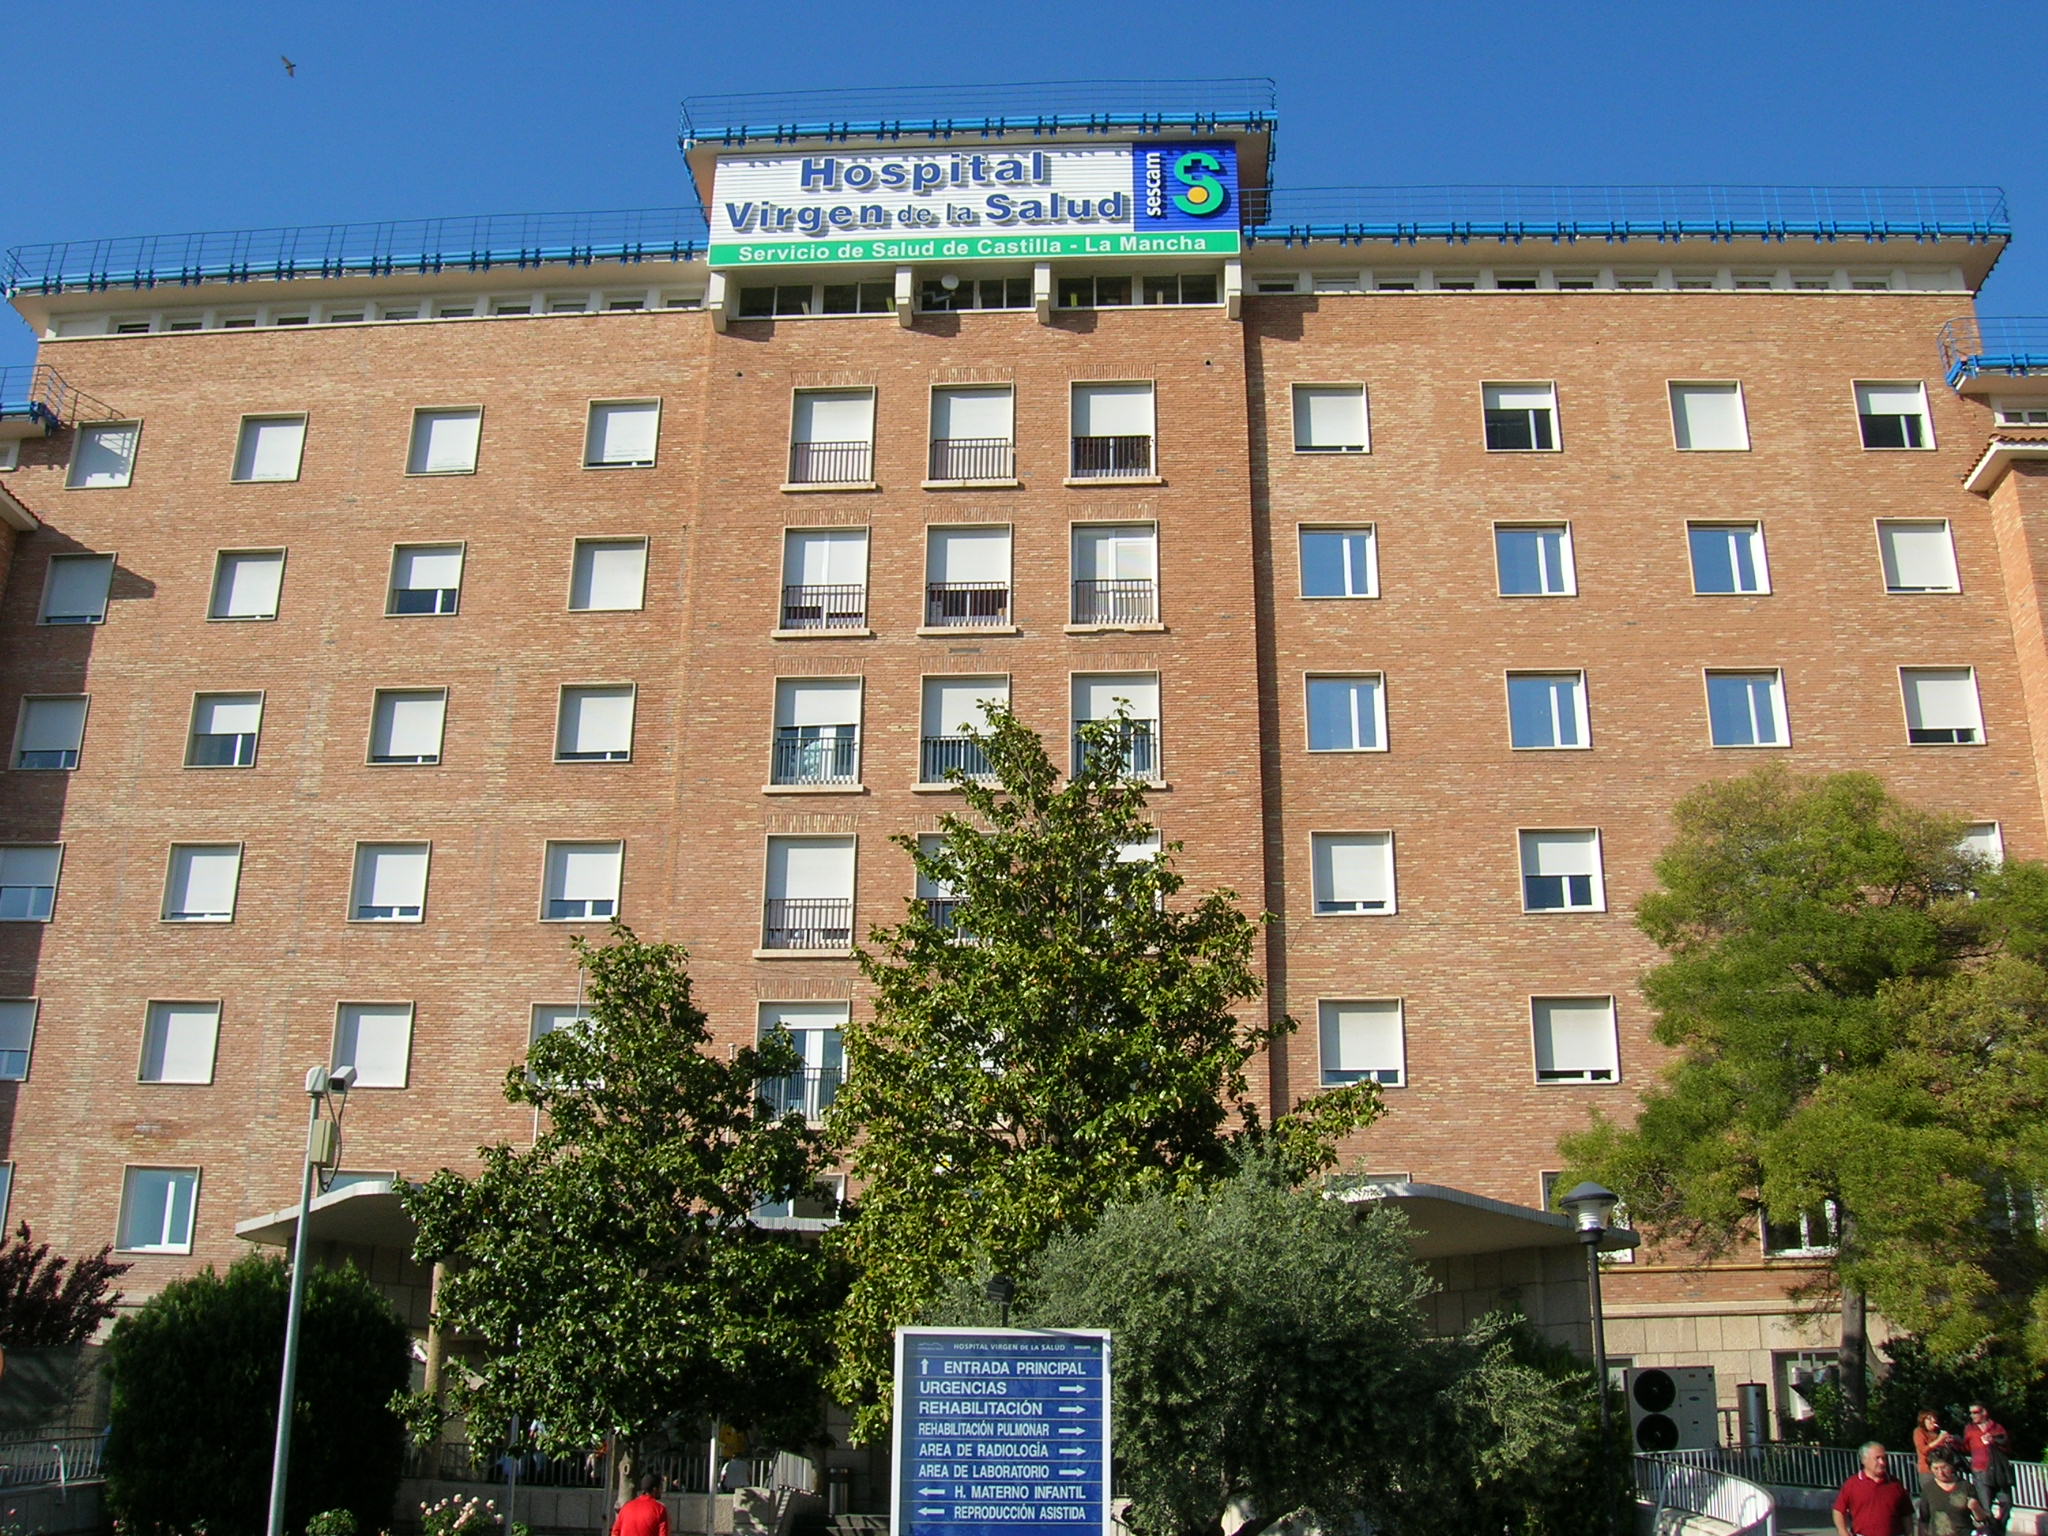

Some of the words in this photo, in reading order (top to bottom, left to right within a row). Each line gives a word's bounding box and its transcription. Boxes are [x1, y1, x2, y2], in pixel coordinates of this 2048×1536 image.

[801, 151, 1043, 191] Hospital
[1146, 152, 1161, 216] sescam
[725, 201, 883, 232] Virgen
[897, 204, 932, 223] de
[946, 203, 973, 222] la
[985, 191, 1123, 221] Salud
[738, 243, 830, 261] Servicio
[837, 242, 864, 258] de
[871, 240, 935, 257] Salud
[942, 240, 969, 255] de
[977, 237, 1062, 254] Castilla
[1086, 237, 1111, 252] La
[1119, 235, 1206, 252] Mancha
[990, 1343, 1018, 1351] VIRGEN
[944, 1361, 1010, 1375] ENTRADA
[1016, 1361, 1086, 1375] PRINCIPAL
[919, 1381, 1007, 1395] URGENCIAS
[919, 1399, 1043, 1415] REHABILITACIÓN
[918, 1420, 994, 1436] REHABILITACIÓN
[997, 1423, 1050, 1436] PULMONAR
[919, 1443, 951, 1457] AREA
[956, 1444, 973, 1457] DE
[977, 1442, 1049, 1457] RADIOLOGÍA
[919, 1465, 949, 1478] AREA
[953, 1465, 969, 1478] DE
[972, 1465, 1050, 1478] LABORATORIO
[954, 1485, 966, 1499] H.
[971, 1485, 1029, 1499] MATERNO
[1034, 1485, 1086, 1499] INFANTIL
[954, 1503, 1035, 1519] REPRODUCCIÓN
[1039, 1506, 1086, 1520] ASISTIDA
